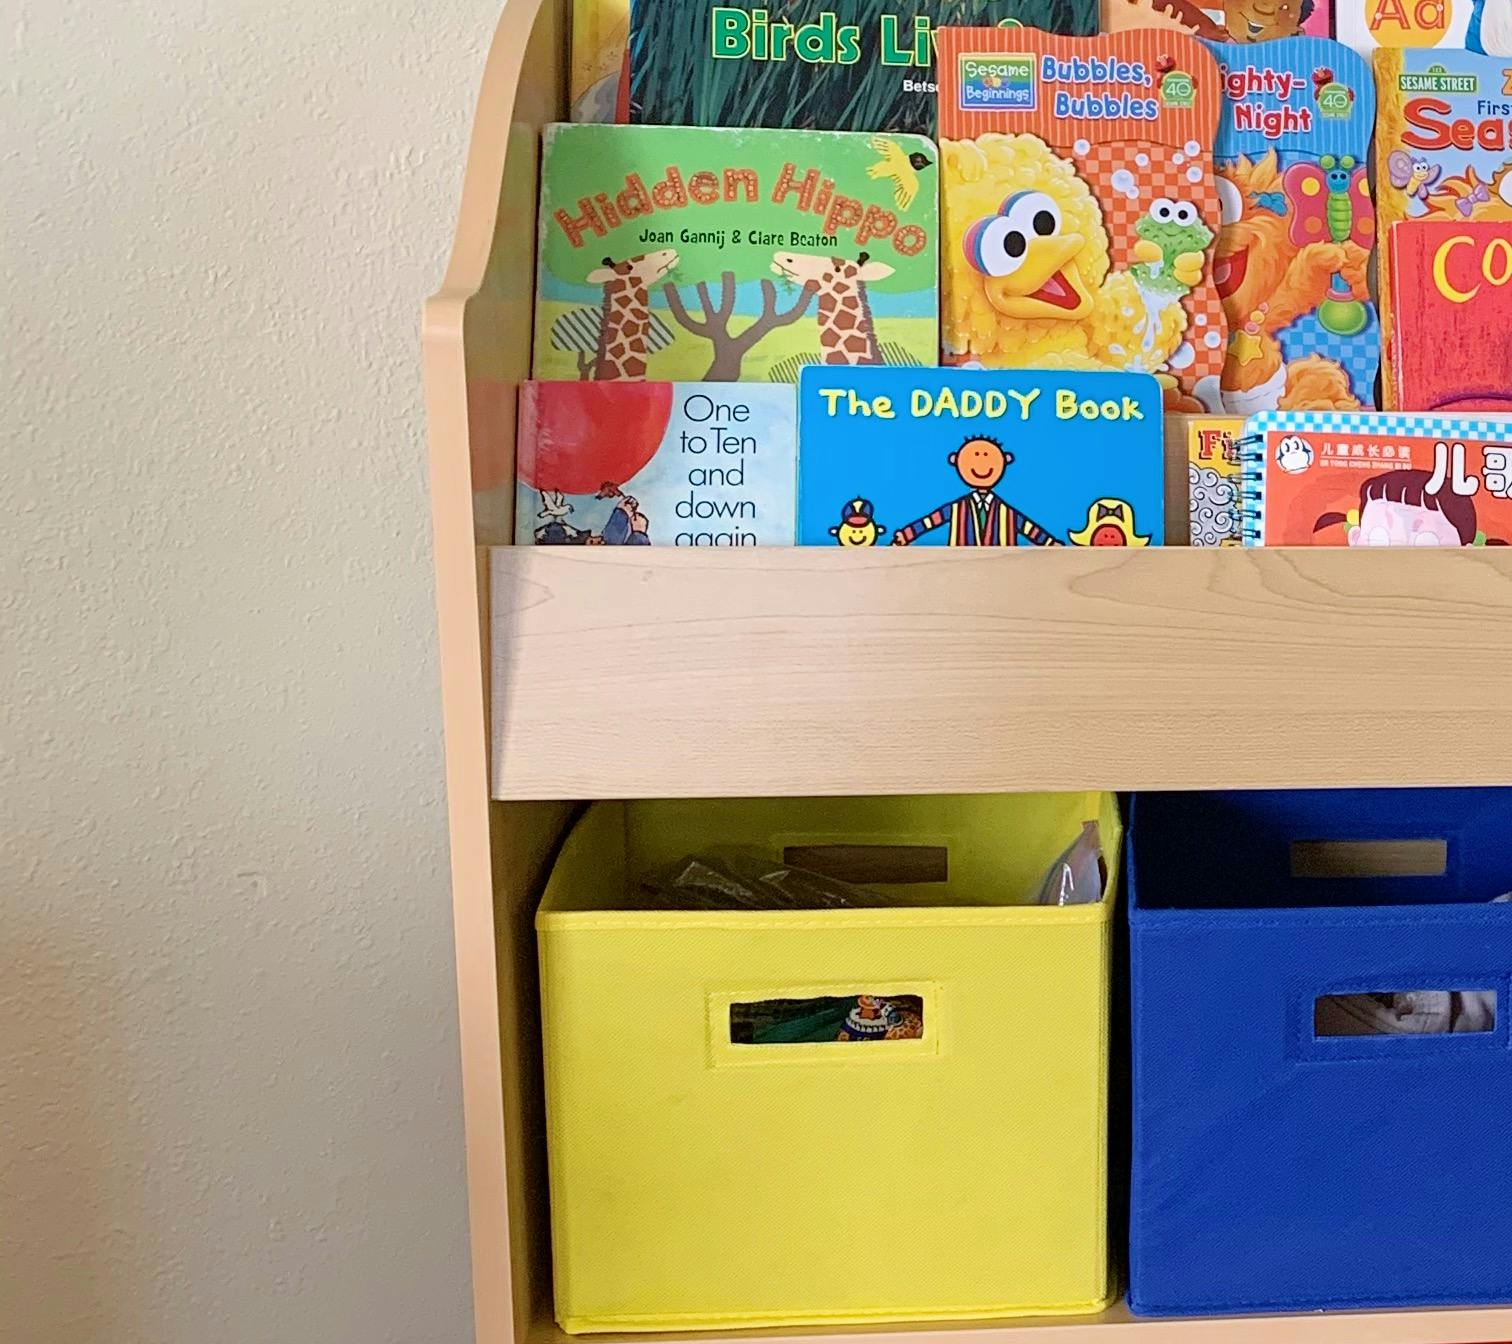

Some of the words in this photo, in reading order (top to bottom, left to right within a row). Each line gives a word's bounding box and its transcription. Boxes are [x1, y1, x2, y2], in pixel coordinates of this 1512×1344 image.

[711, 7, 860, 65] Birds
[965, 61, 1029, 78] Sesame
[1041, 55, 1153, 87] Bubbles,
[1219, 64, 1307, 101] ighty-
[966, 86, 1029, 102] Beginnings
[1400, 77, 1439, 91] SESAME
[1440, 78, 1475, 91] STREET
[1055, 92, 1160, 120] Bubbles
[1234, 102, 1312, 139] Night
[553, 165, 759, 249] Hidden
[771, 161, 928, 256] Hippo
[639, 229, 674, 244] Joan
[680, 229, 725, 249] Gannij
[731, 230, 741, 244] &
[749, 231, 785, 246] Clare
[790, 232, 838, 247] Beaton
[683, 394, 751, 423] One
[818, 388, 896, 419] The
[910, 388, 1041, 421] DADDY
[1055, 389, 1145, 421] Book
[680, 430, 707, 454] to
[710, 427, 757, 455] Ten
[688, 458, 744, 486] and
[675, 491, 756, 519] down
